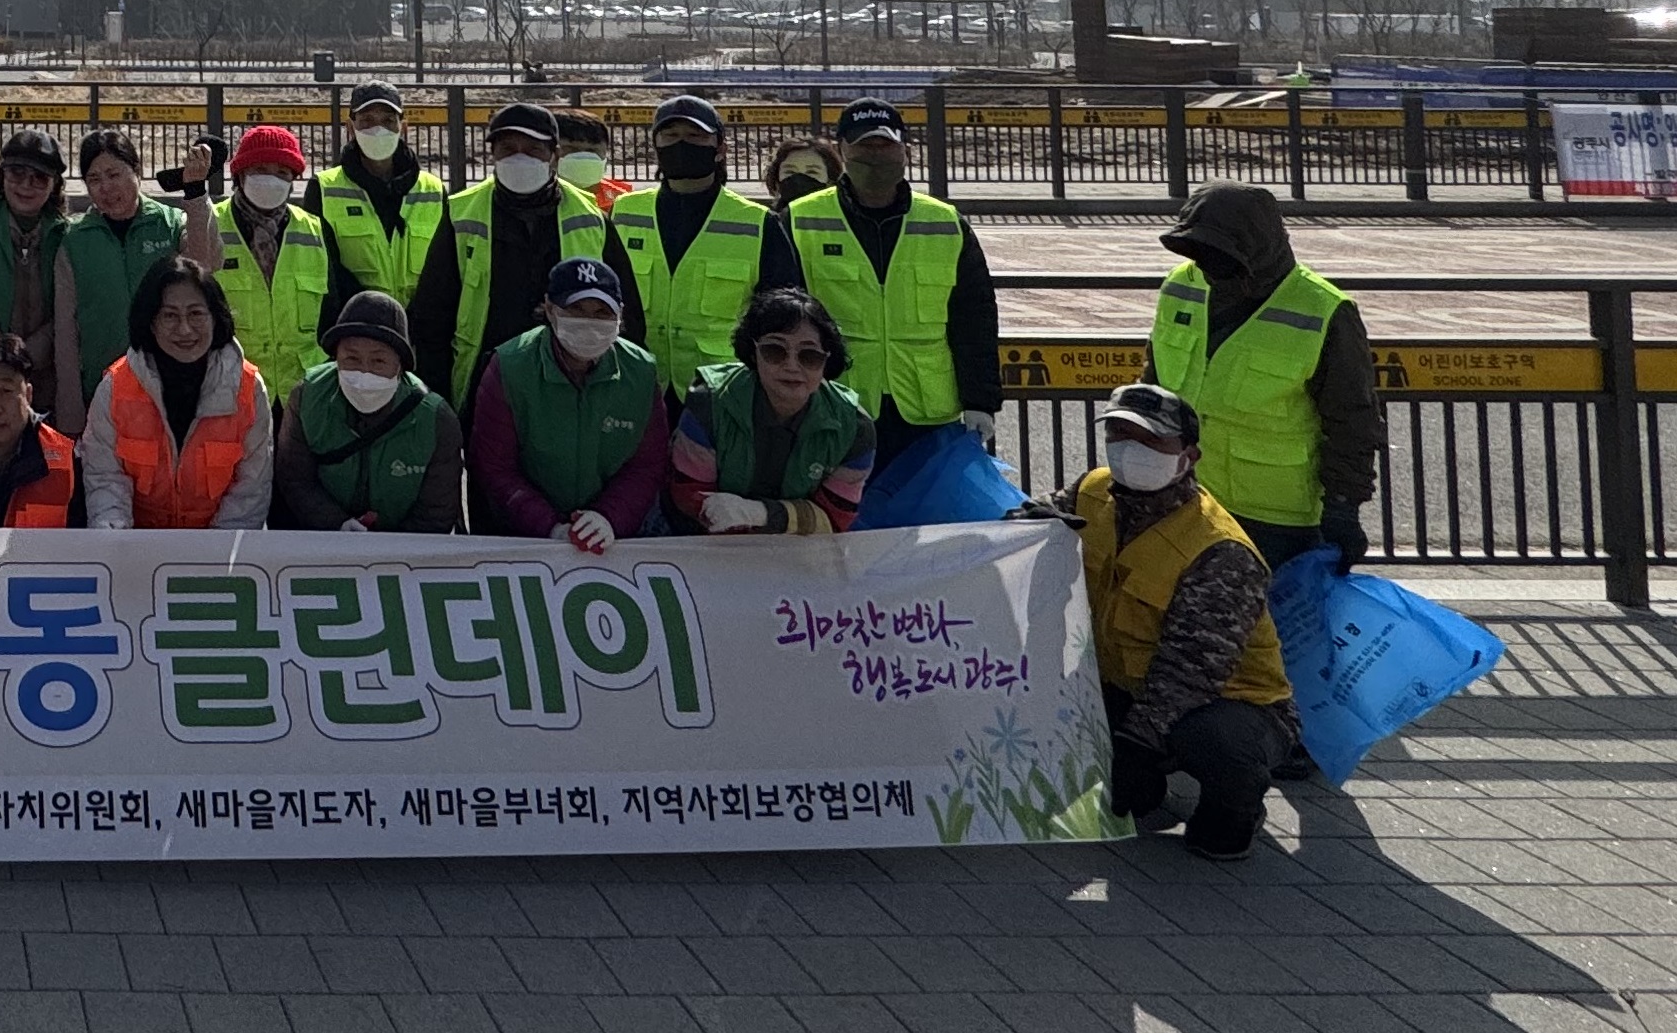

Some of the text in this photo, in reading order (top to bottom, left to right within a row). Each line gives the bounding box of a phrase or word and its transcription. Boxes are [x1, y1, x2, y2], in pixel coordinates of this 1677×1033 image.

[852, 109, 890, 122] Volvik
[577, 263, 599, 283] NY
[1061, 351, 1144, 369] 어린이보호
[1418, 353, 1536, 370] 어린이보호구역
[1075, 373, 1126, 385] SCHOOL
[1433, 375, 1522, 387] SCHOOL ZONE
[776, 599, 886, 652] 희망찬
[155, 573, 700, 728] 클린데이
[176, 787, 387, 831] 새마을지도자,
[400, 784, 610, 829] 새마을부녀회,
[624, 779, 915, 825] 지역사회보장협의체
